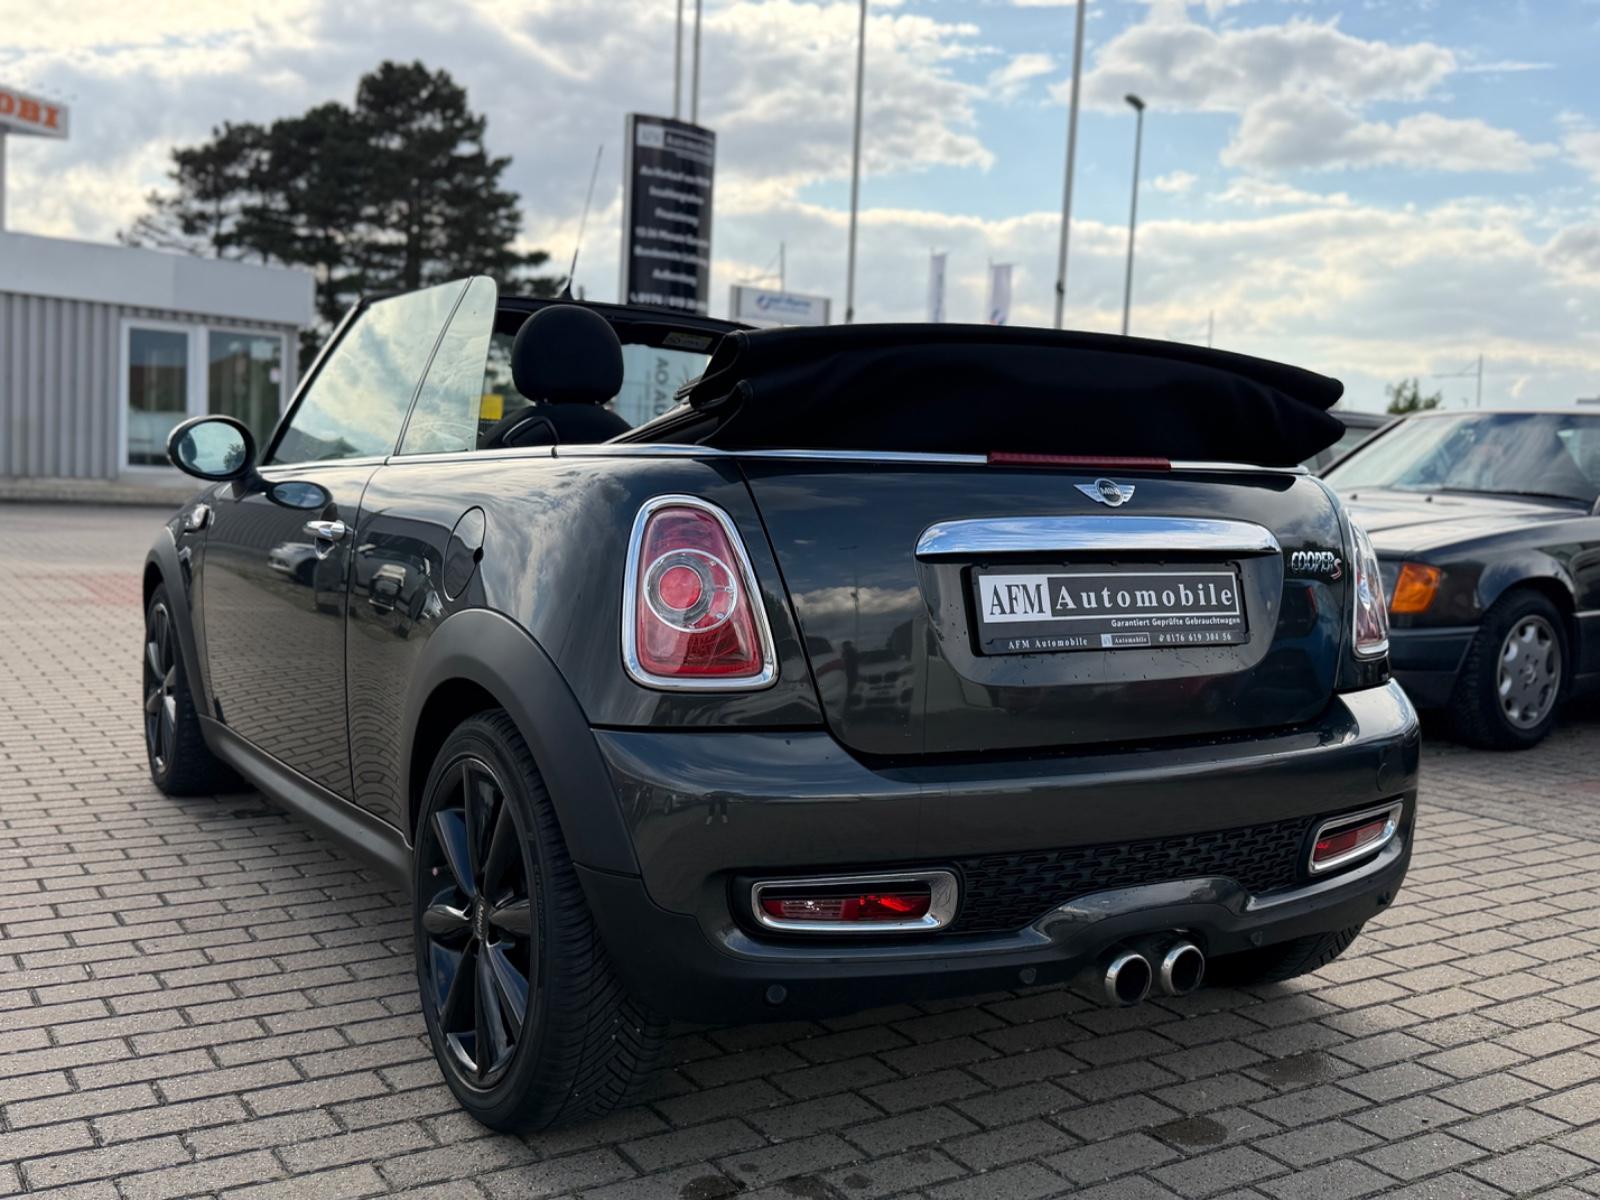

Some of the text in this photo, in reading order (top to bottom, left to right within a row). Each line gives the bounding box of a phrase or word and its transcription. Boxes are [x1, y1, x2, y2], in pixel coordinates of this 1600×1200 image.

[1291, 550, 1341, 580] COOPER S
[989, 582, 1234, 616] AFM Automobile
[1111, 618, 1150, 628] Garantiert
[1152, 617, 1183, 628] Geprüfte
[1008, 637, 1088, 650] AFM Automobile
